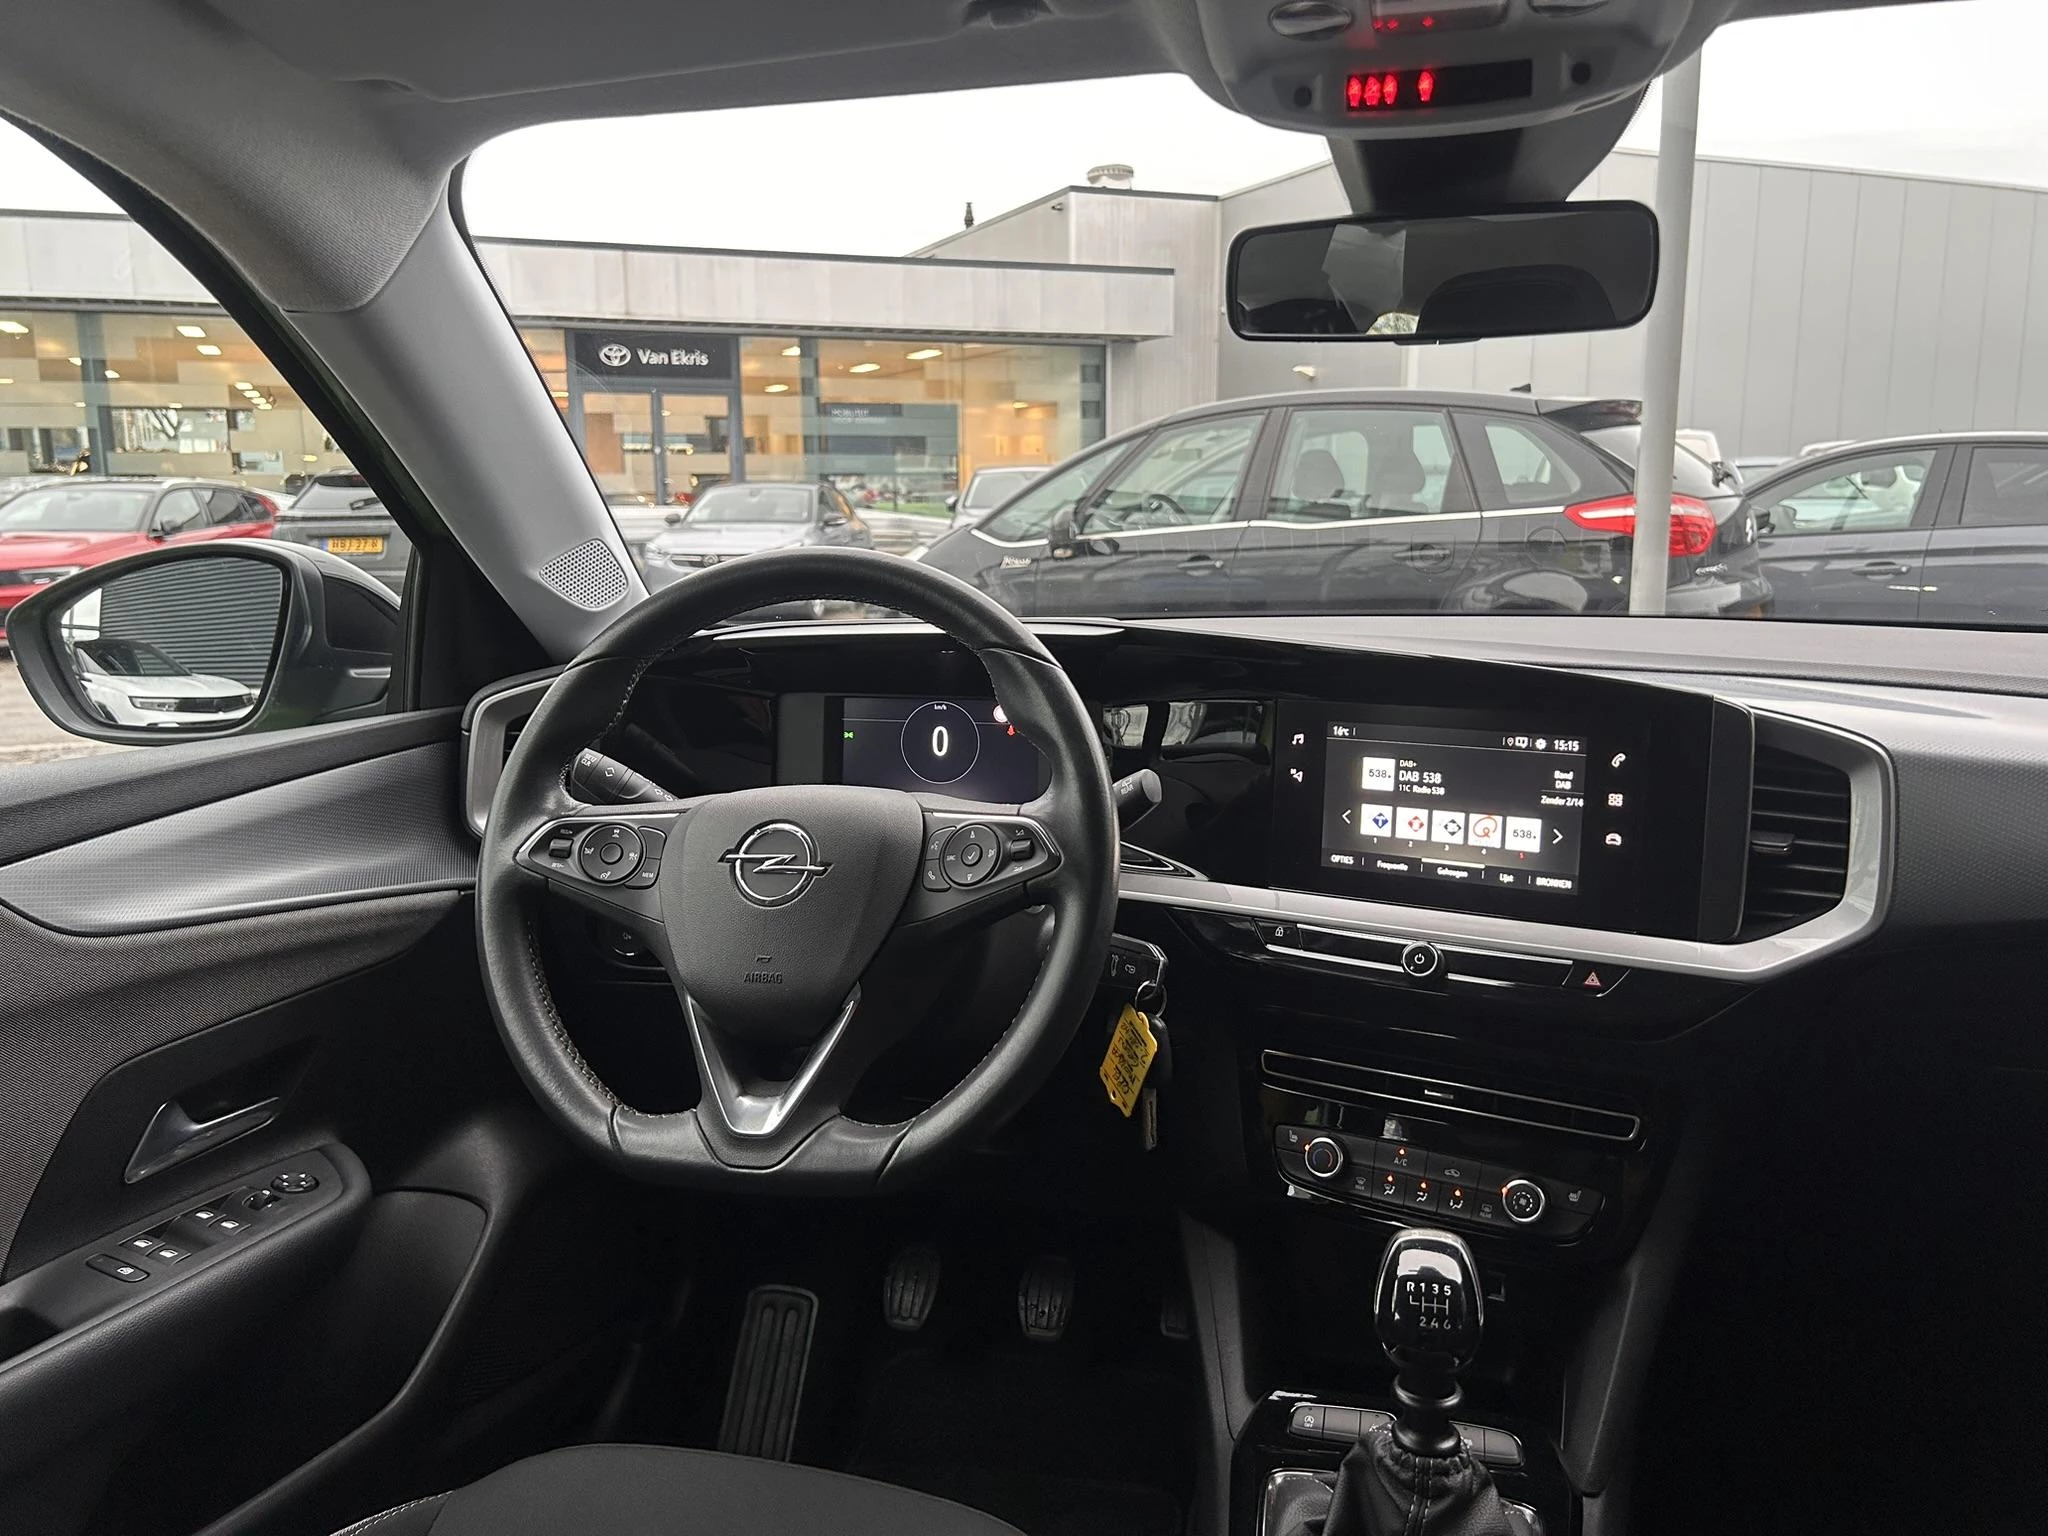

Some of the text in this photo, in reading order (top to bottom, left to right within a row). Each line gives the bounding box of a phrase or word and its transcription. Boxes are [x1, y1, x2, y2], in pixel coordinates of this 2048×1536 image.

[637, 348, 709, 366] Van Ekris
[932, 725, 949, 757] 0
[1553, 739, 1580, 752] 15:15
[1398, 770, 1442, 784] DAB 538
[743, 971, 783, 985] AIRBAG
[1394, 1156, 1408, 1167] A/C
[1406, 1281, 1415, 1293] R
[1432, 1283, 1439, 1295] 3
[1443, 1284, 1452, 1296] 5
[1419, 1316, 1427, 1327] 2
[1430, 1317, 1439, 1329] 4
